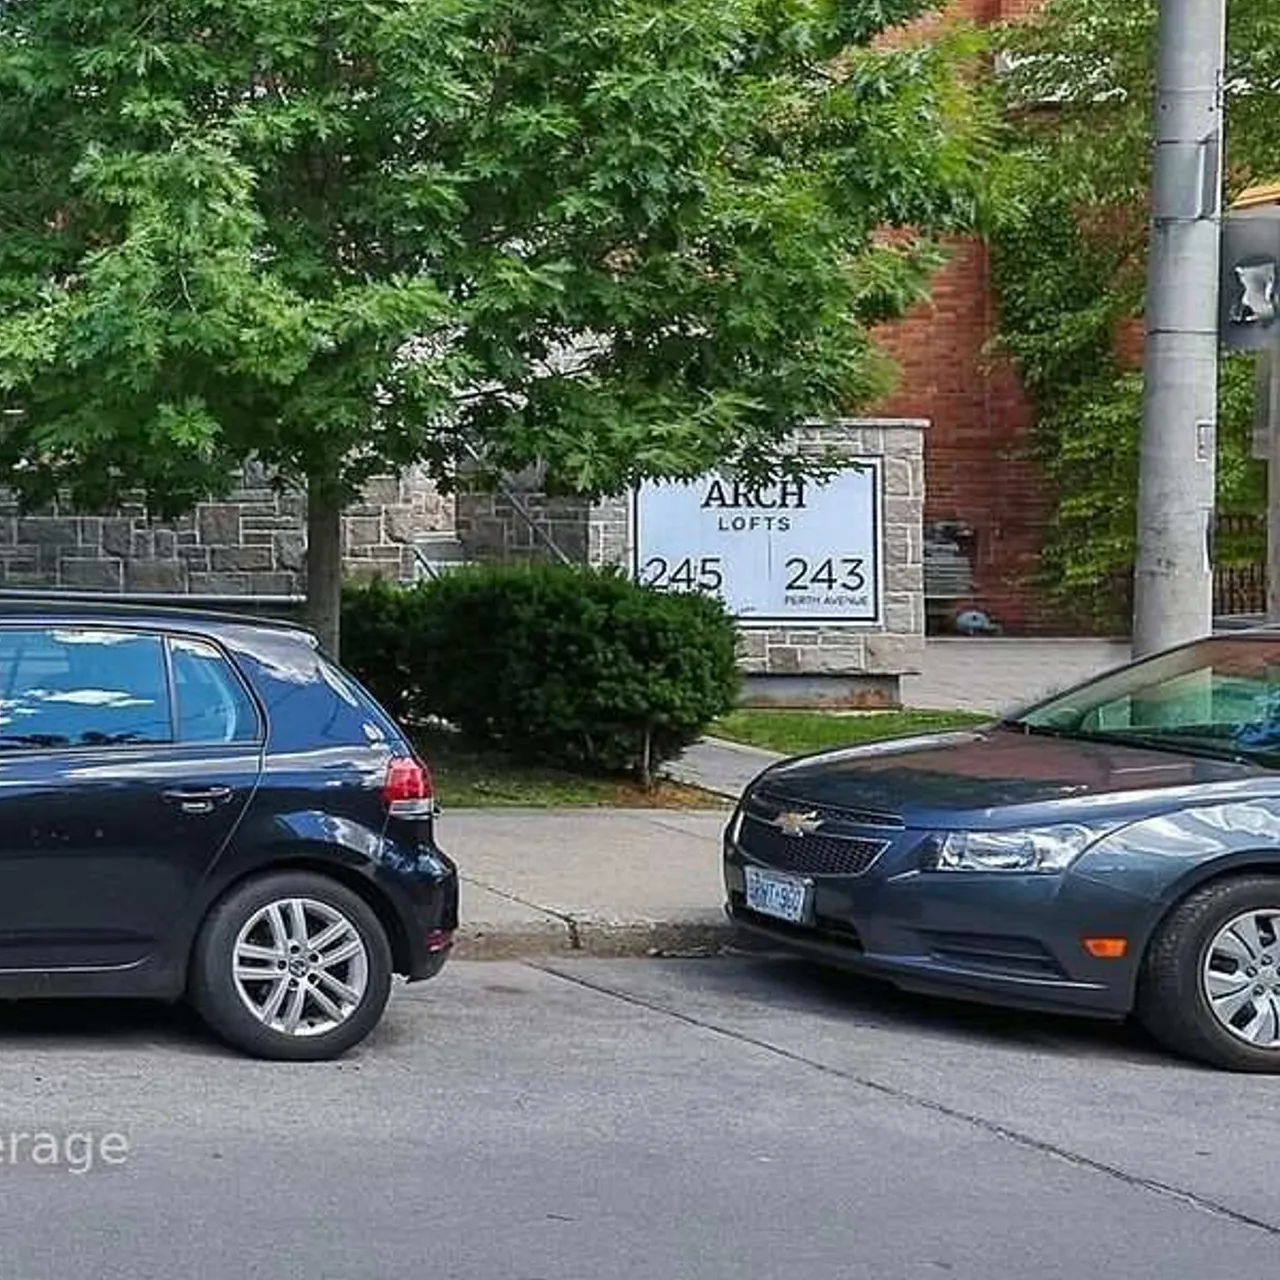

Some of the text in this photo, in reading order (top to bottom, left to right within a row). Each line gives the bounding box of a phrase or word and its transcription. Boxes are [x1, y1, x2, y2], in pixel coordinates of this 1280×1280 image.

[700, 479, 807, 509] ARCH
[718, 516, 791, 532] LOFTS
[645, 557, 723, 591] 245
[785, 557, 866, 591] 243
[784, 595, 869, 606] PERTH AVENUE
